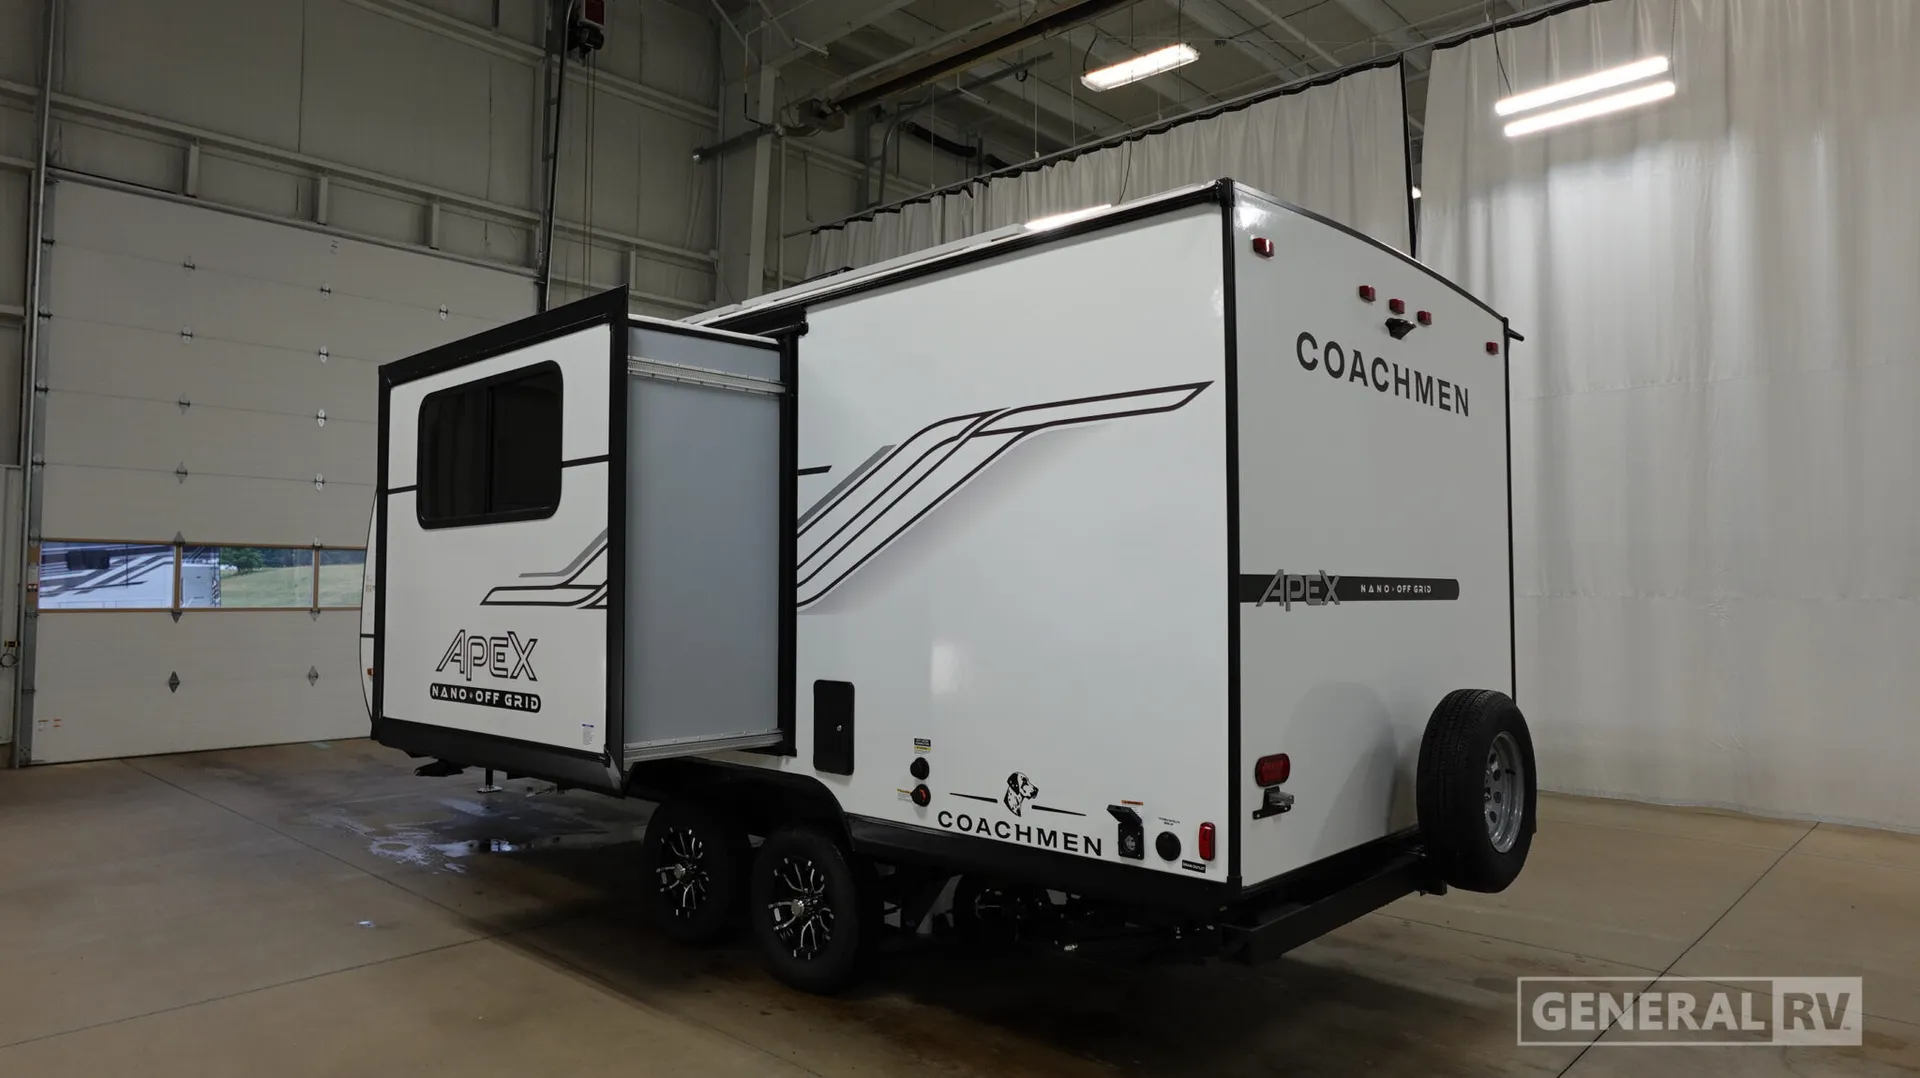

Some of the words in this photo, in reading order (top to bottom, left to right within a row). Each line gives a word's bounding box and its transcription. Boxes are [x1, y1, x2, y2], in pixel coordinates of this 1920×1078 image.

[1296, 331, 1469, 417] COACHMEN
[1255, 568, 1341, 612] APEX
[1360, 584, 1390, 594] NANO
[1396, 584, 1412, 594] OFF
[1413, 584, 1432, 594] GRID
[435, 629, 539, 682] APEX
[431, 685, 467, 700] NANO
[475, 690, 500, 705] OFF
[504, 693, 539, 710] GRID
[937, 810, 1102, 857] COACHMEN
